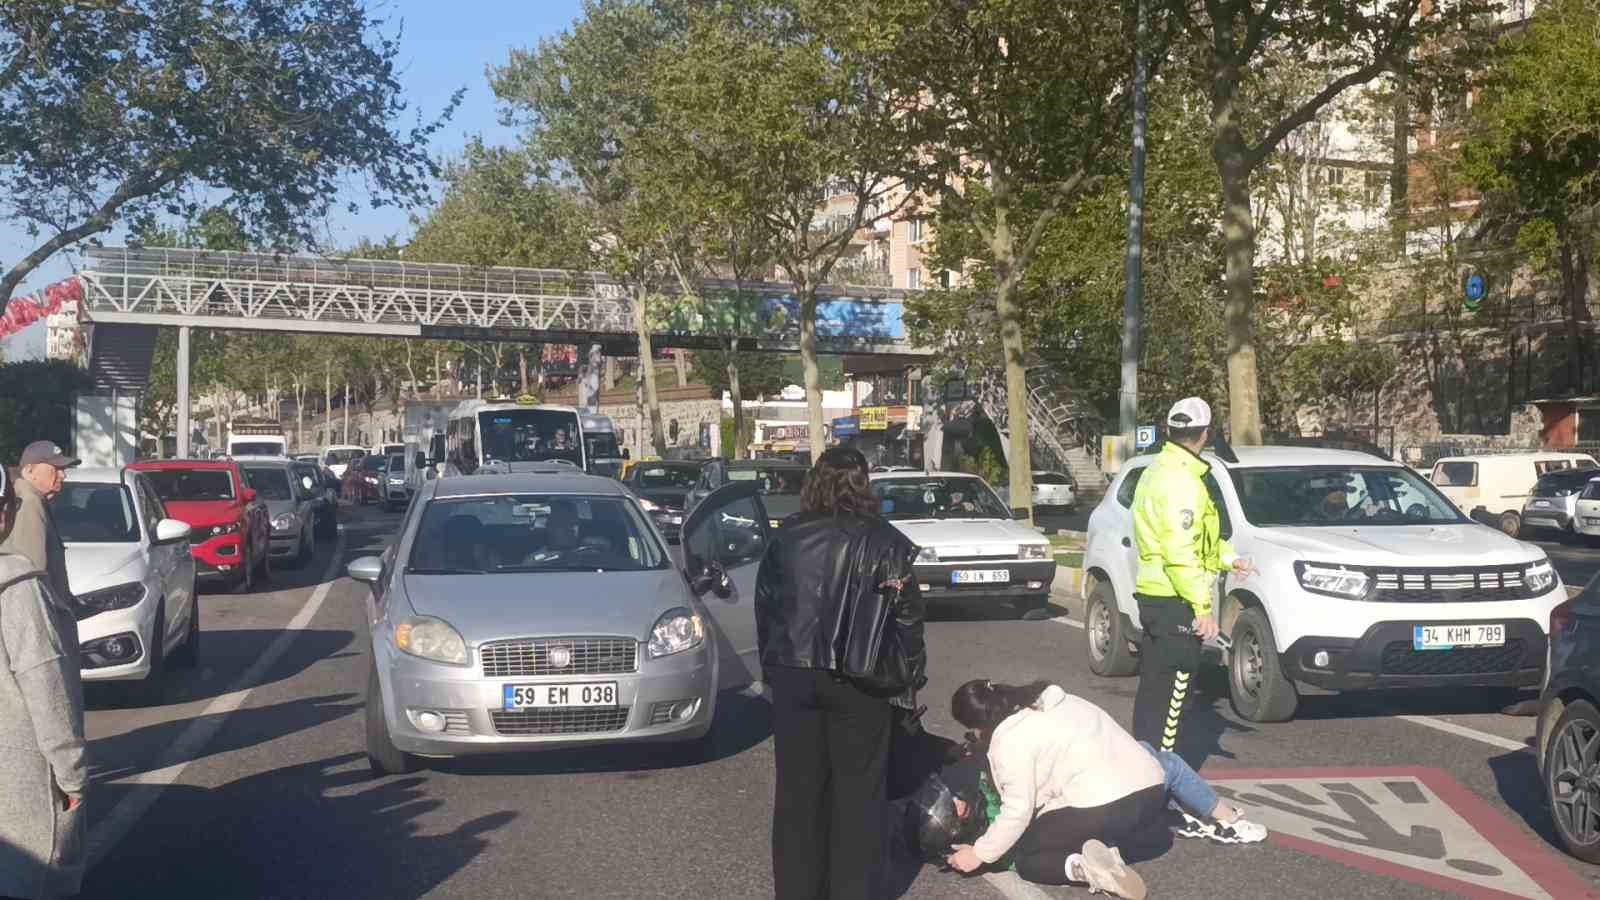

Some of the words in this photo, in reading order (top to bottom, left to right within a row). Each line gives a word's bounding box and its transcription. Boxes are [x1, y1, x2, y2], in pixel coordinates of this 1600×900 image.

[960, 571, 969, 582] 59
[1423, 628, 1439, 644] 34
[1447, 627, 1471, 643] KHM
[1478, 626, 1502, 642] 789
[514, 688, 535, 706] 59
[548, 687, 569, 705] EM
[582, 686, 613, 704] 038
